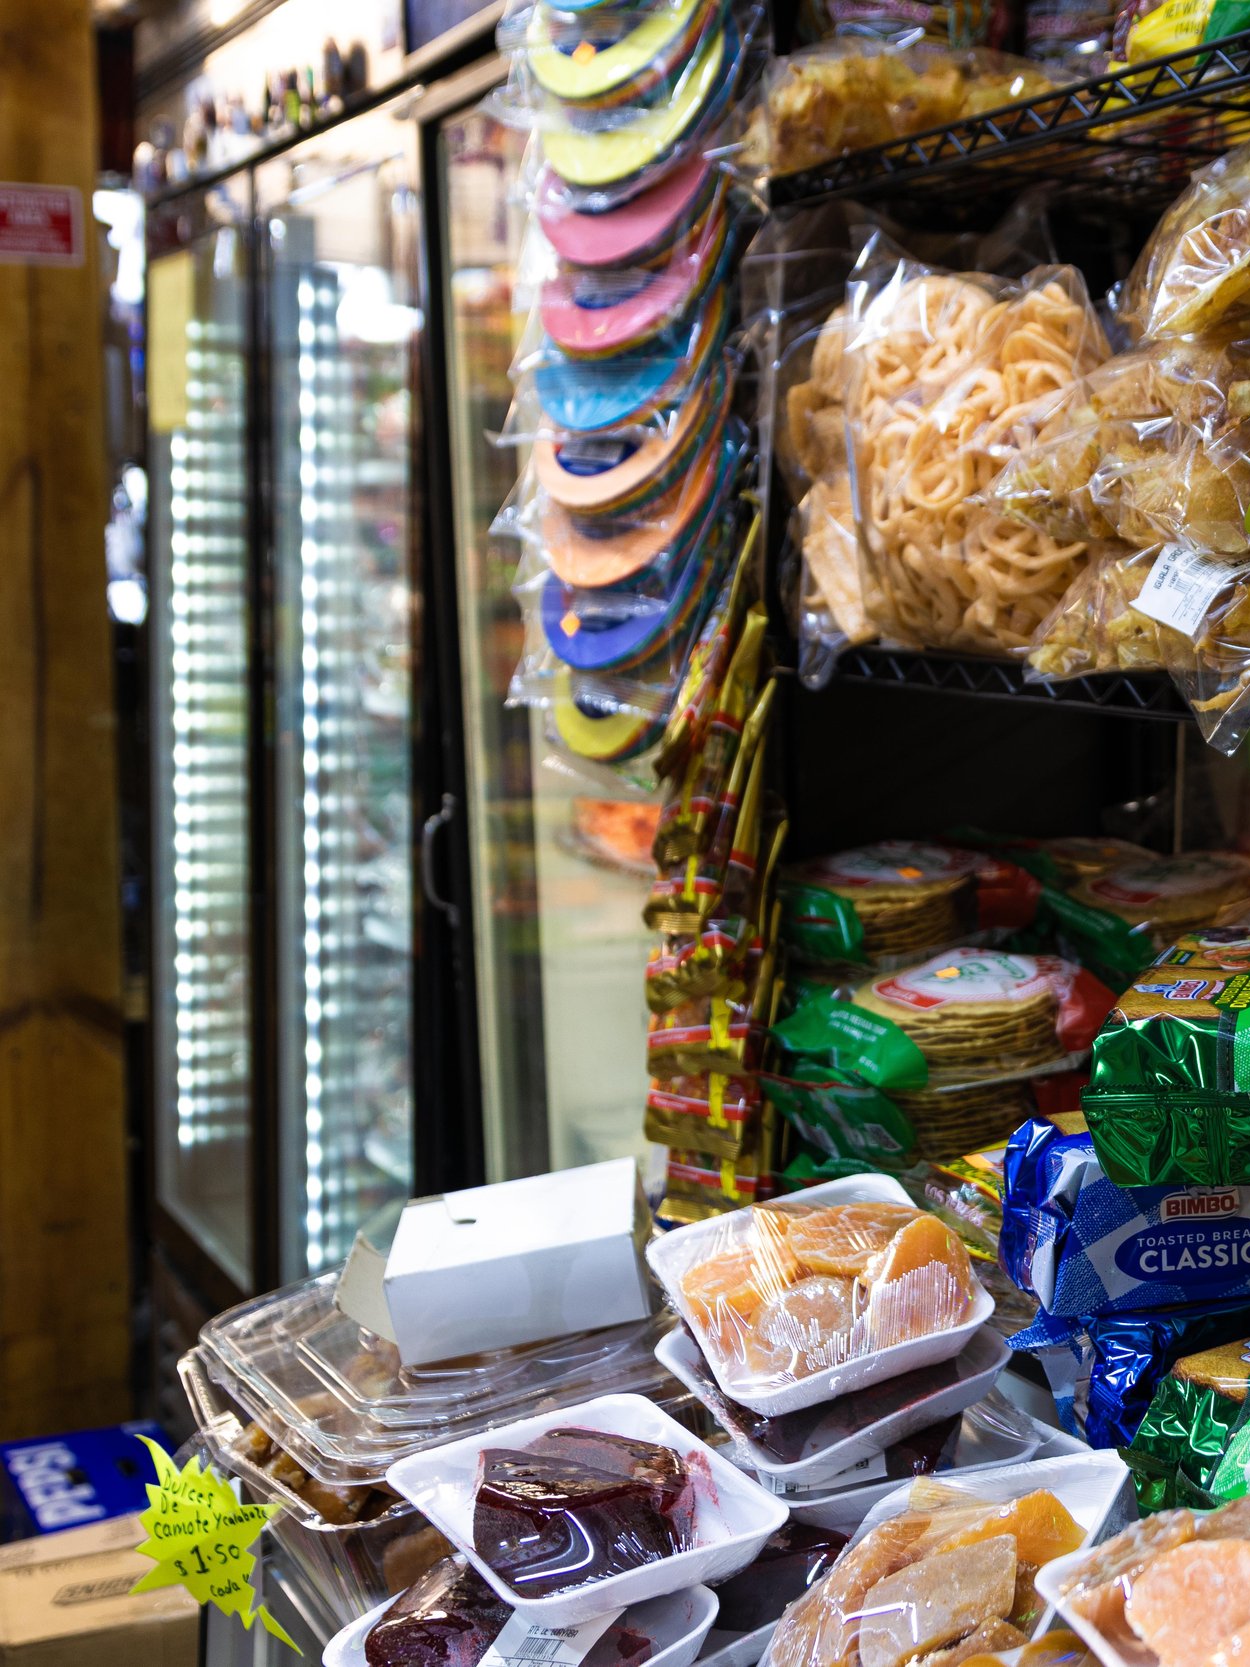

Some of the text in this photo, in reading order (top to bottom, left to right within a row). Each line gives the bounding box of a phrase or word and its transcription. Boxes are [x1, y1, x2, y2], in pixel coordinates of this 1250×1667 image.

[1166, 1195, 1235, 1216] BIMBO
[1137, 1233, 1205, 1247] TOASTED
[163, 1469, 213, 1508] Dulces
[161, 1492, 178, 1514] De
[528, 1626, 540, 1635] ATE
